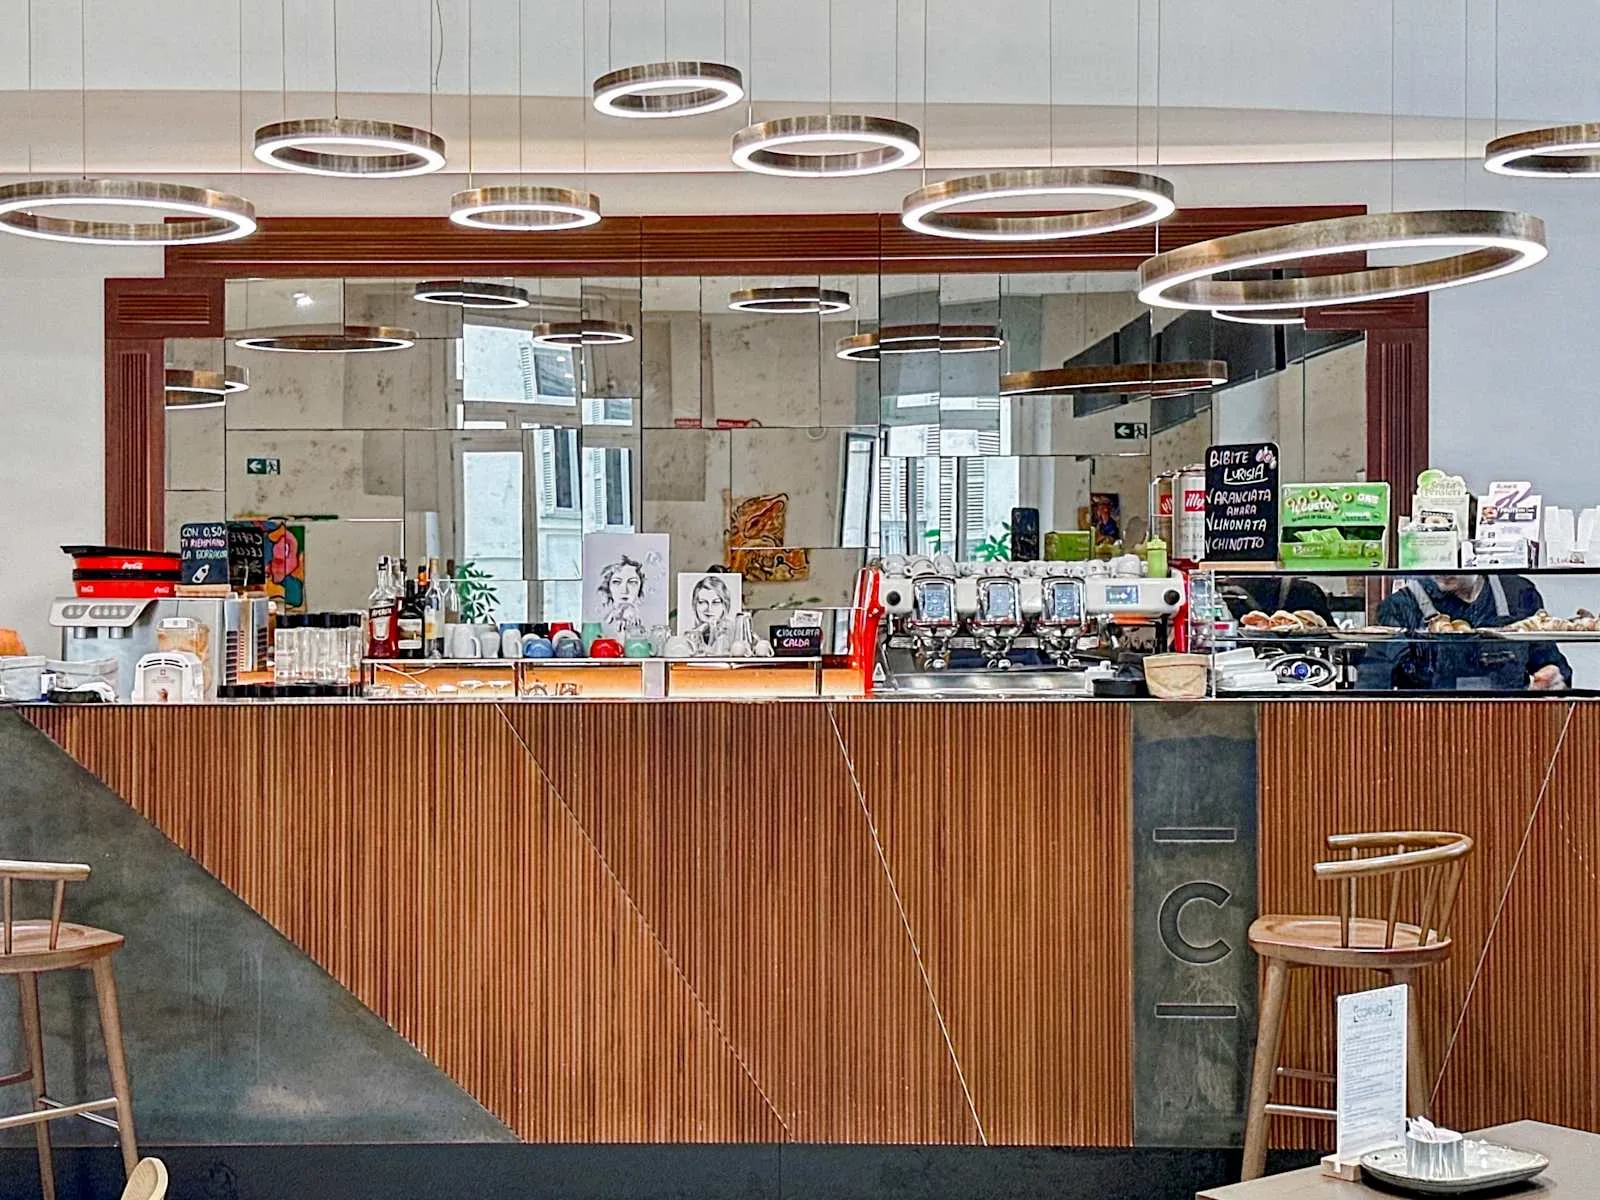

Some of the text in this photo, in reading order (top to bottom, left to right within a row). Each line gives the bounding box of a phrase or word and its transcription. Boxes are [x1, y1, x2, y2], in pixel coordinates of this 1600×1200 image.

[1210, 450, 1249, 468] BIBITE
[1224, 463, 1265, 481] LURISIA
[1185, 493, 1205, 510] illy
[1214, 489, 1272, 505] ARANCIATA
[1226, 504, 1257, 516] AMARA
[1213, 518, 1267, 532] LIMONATA
[182, 527, 199, 538] CON
[181, 538, 189, 549] TI
[1211, 536, 1265, 551] CHINOTTO
[182, 550, 192, 560] LA
[776, 628, 820, 638] CIOCCOLATA
[783, 638, 810, 648] CALDA
[1157, 879, 1232, 967] C
